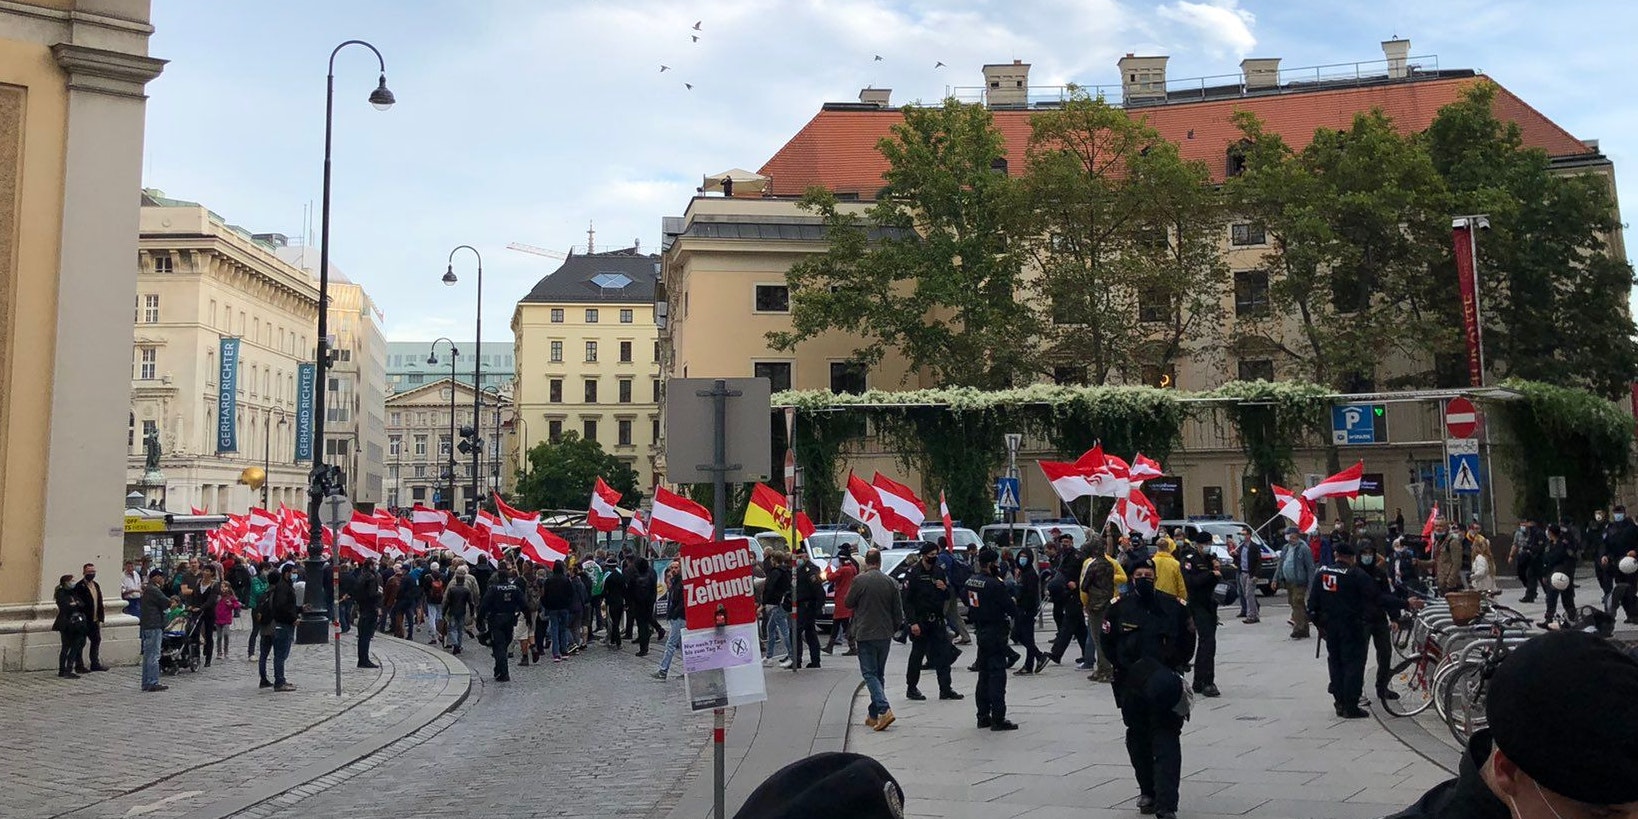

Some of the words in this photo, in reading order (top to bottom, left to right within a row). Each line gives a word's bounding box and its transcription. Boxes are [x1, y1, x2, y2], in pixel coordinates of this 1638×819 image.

[222, 342, 235, 391] RICHTER
[301, 367, 312, 409] RICHTER
[221, 393, 232, 447] GERHARD
[299, 409, 310, 457] GERHARD
[680, 548, 750, 581] Kronen
[683, 575, 755, 607] Zeitung
